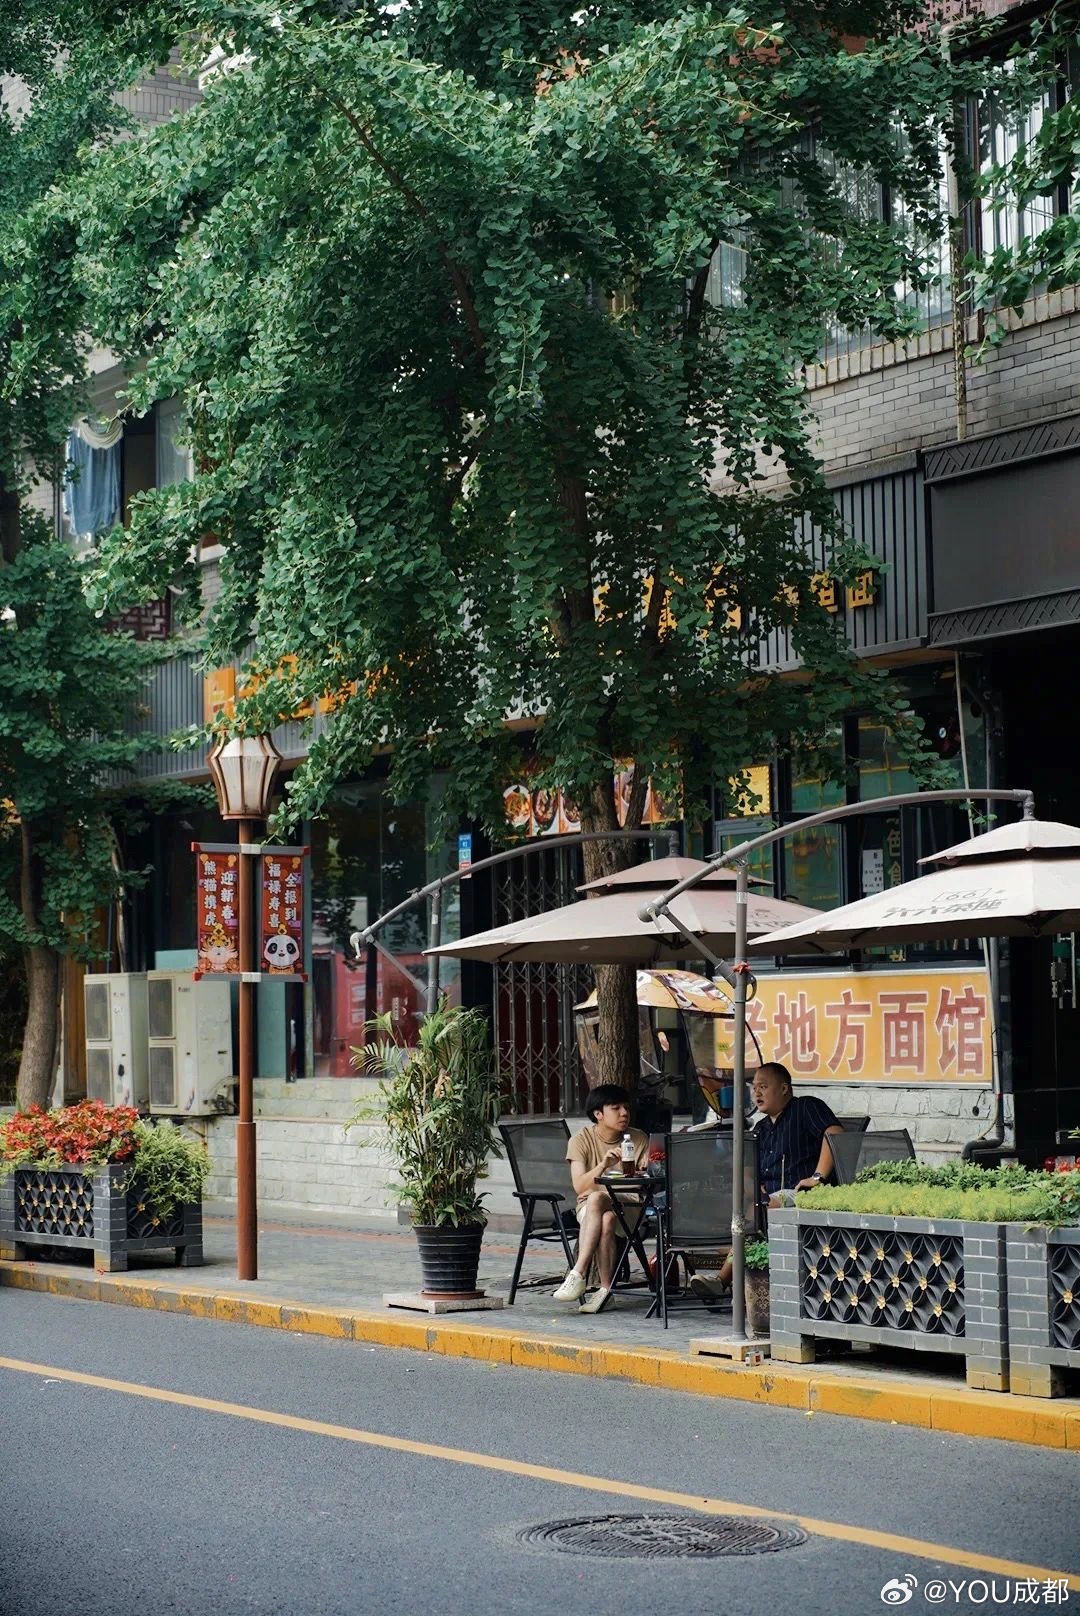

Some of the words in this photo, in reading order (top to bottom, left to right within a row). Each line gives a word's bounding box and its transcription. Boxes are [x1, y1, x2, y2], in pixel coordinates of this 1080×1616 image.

[221, 871, 234, 919] 迎新春
[268, 863, 281, 928] 福禄寿喜
[284, 873, 297, 920] 全报到
